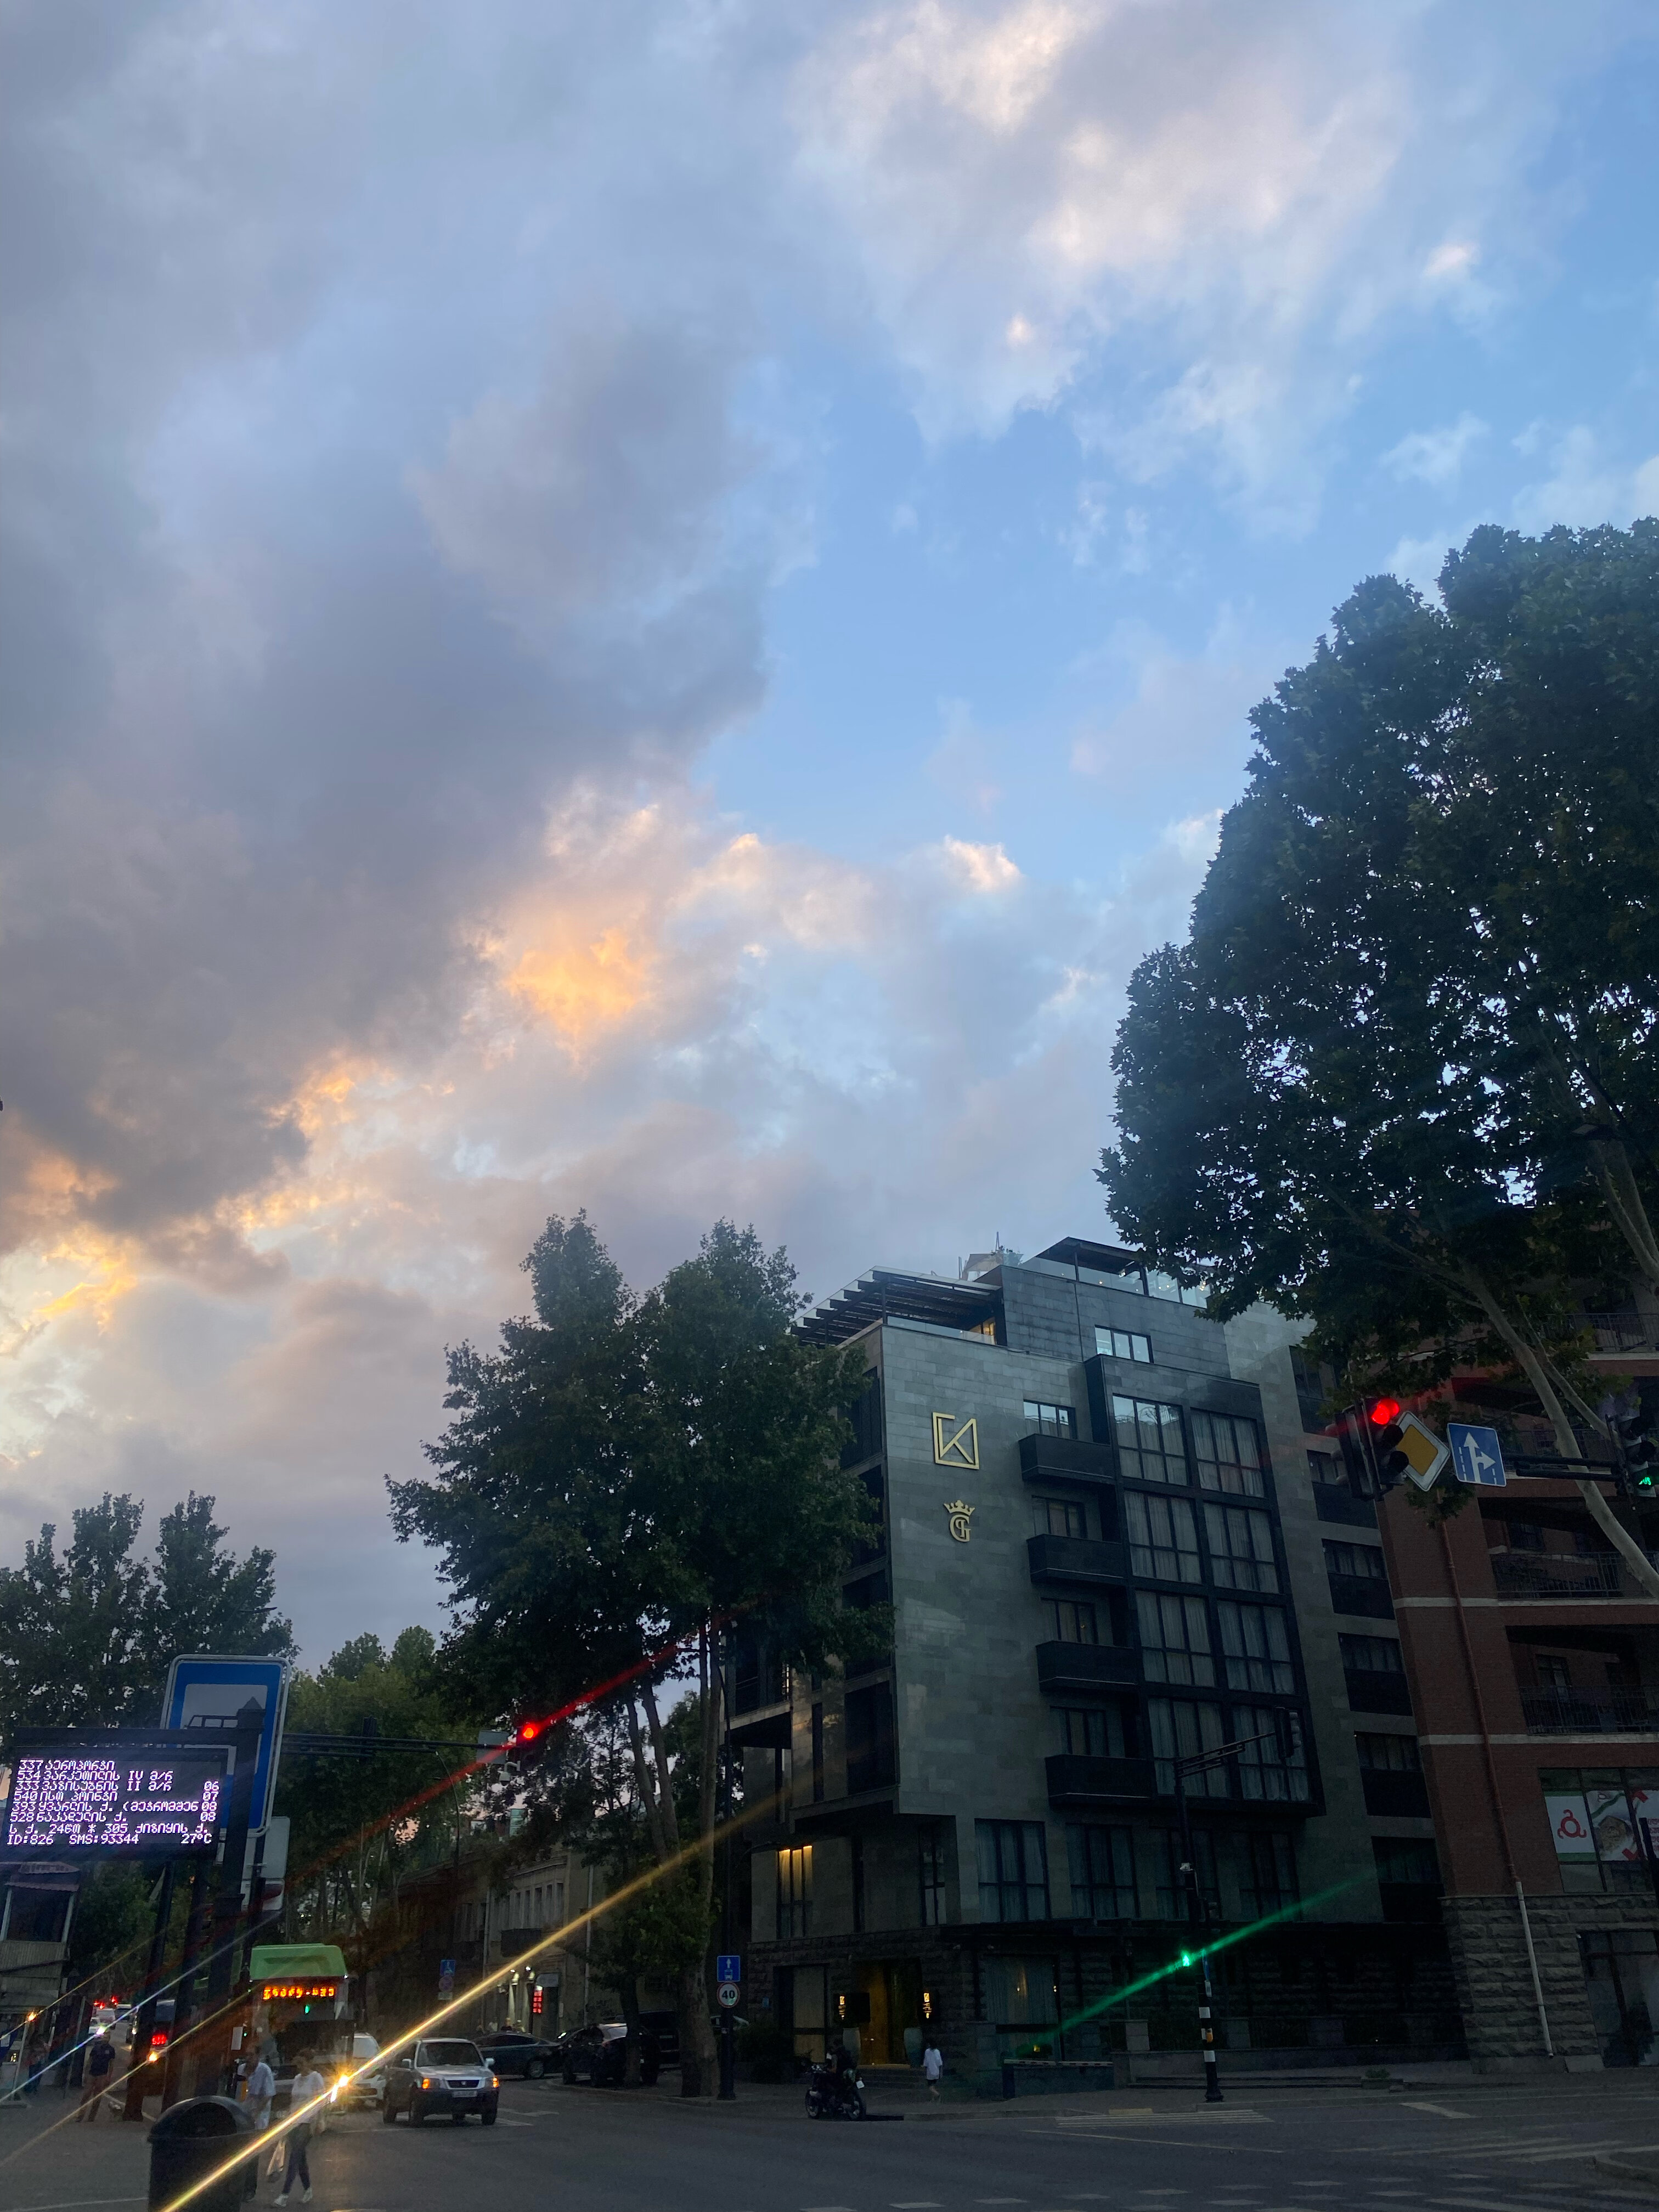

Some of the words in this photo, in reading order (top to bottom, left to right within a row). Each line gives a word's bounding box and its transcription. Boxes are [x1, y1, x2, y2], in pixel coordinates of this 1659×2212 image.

[19, 1760, 44, 1770] 337
[44, 1760, 115, 1771] აეროპორტი
[17, 1770, 42, 1781] 534
[43, 1770, 121, 1781] ვარკეთილის
[128, 1771, 144, 1781] IV
[15, 1781, 40, 1791] 333
[127, 1781, 141, 1791] II
[204, 1781, 219, 1791] 06
[13, 1791, 38, 1802] 540
[39, 1791, 64, 1802] ისთ
[202, 1791, 219, 1802] 07
[12, 1802, 37, 1812] 393
[38, 1801, 94, 1812] ყვარლის
[201, 1801, 217, 1812] 08
[9, 1812, 35, 1822] 528
[200, 1812, 216, 1822] 08
[104, 1824, 129, 1834] 305
[7, 1833, 54, 1845] ID:826
[69, 1833, 139, 1844] SMS:93344
[722, 1990, 735, 2000] 40
